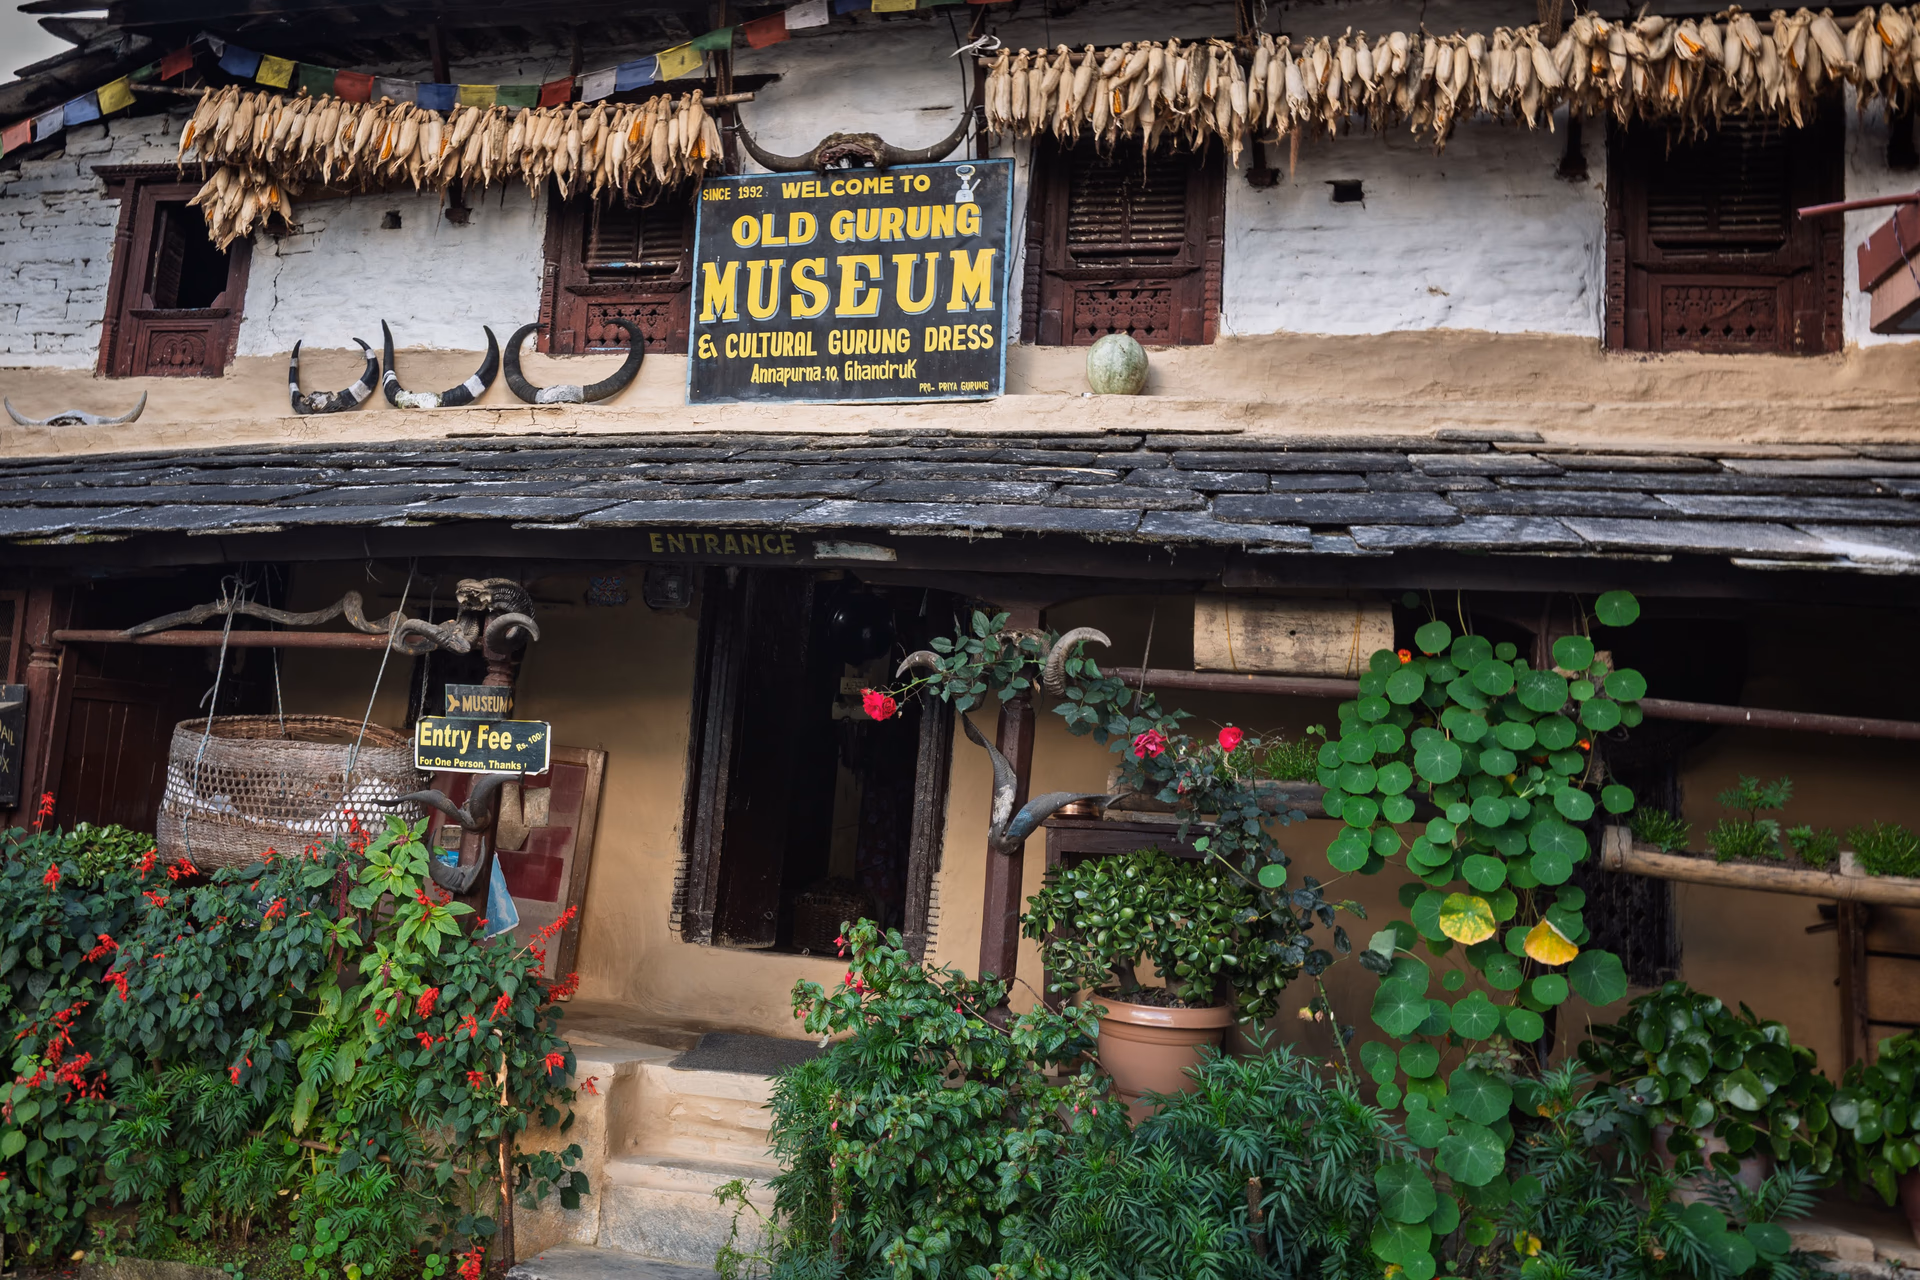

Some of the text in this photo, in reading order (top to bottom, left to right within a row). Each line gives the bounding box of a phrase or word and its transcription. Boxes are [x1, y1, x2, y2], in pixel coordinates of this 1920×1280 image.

[702, 185, 763, 201] SINCE 1992
[782, 175, 930, 198] WELCOME TO
[732, 203, 982, 248] OLD GURUNG
[699, 248, 998, 324] MUSEUM
[698, 324, 993, 359] & CULTURAL GURUNG DRESS
[939, 382, 958, 392] PRIYA
[961, 381, 989, 391] GURUNG
[649, 533, 795, 555] ENTRANCE
[462, 695, 508, 712] MUSEUM
[0, 719, 15, 746] AIL
[420, 722, 512, 754] Entry Fee
[420, 757, 433, 765] For
[435, 757, 451, 767] One
[454, 758, 486, 770] Person,
[489, 760, 521, 770] Thanks
